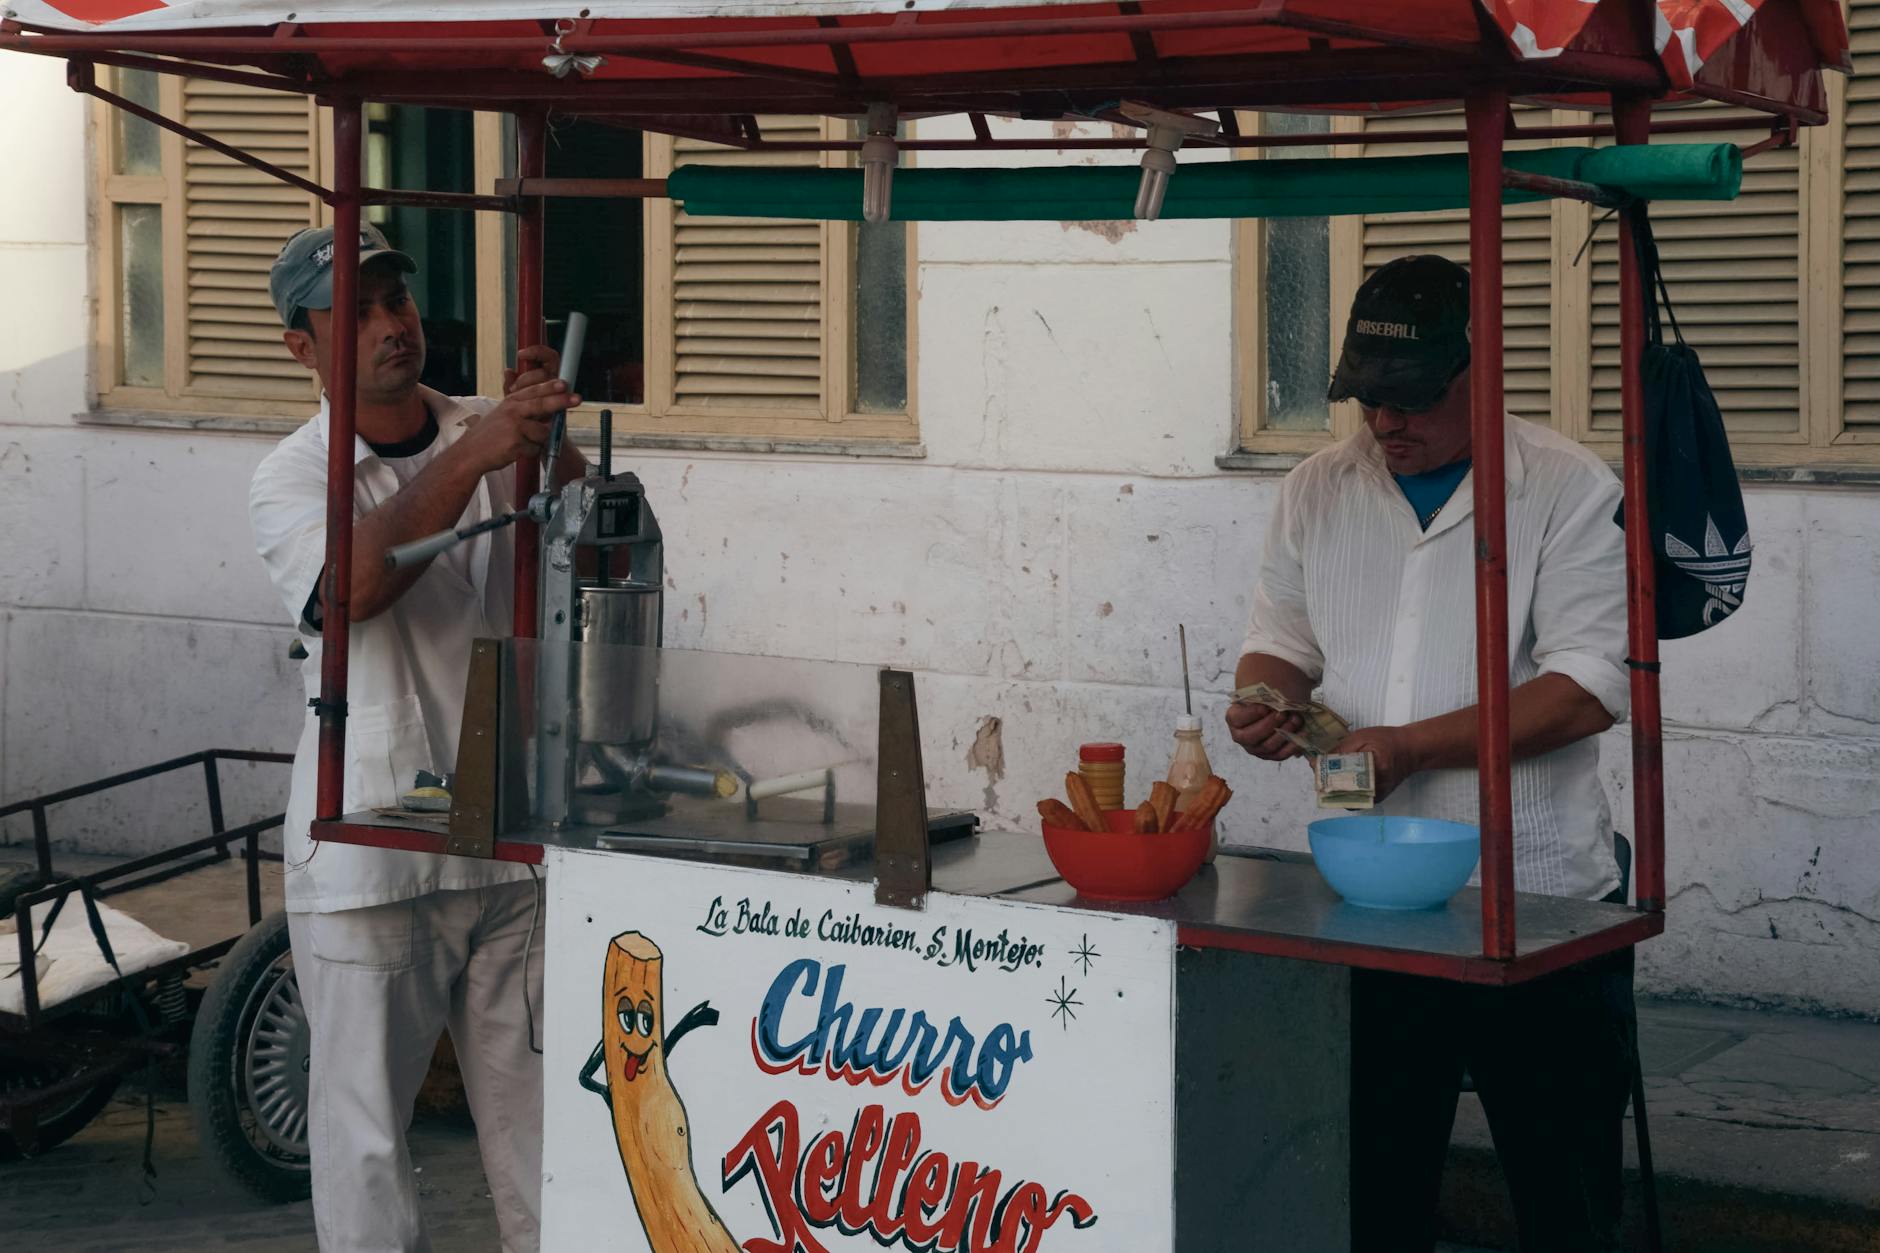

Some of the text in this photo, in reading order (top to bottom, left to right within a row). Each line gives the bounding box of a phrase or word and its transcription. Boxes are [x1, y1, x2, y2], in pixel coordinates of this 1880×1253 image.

[1356, 319, 1420, 340] BASEBALL
[696, 895, 729, 937] La
[732, 897, 780, 936] Bala
[785, 907, 811, 938] de
[751, 958, 1034, 1110] Churro
[722, 1100, 1098, 1253] Relleno
